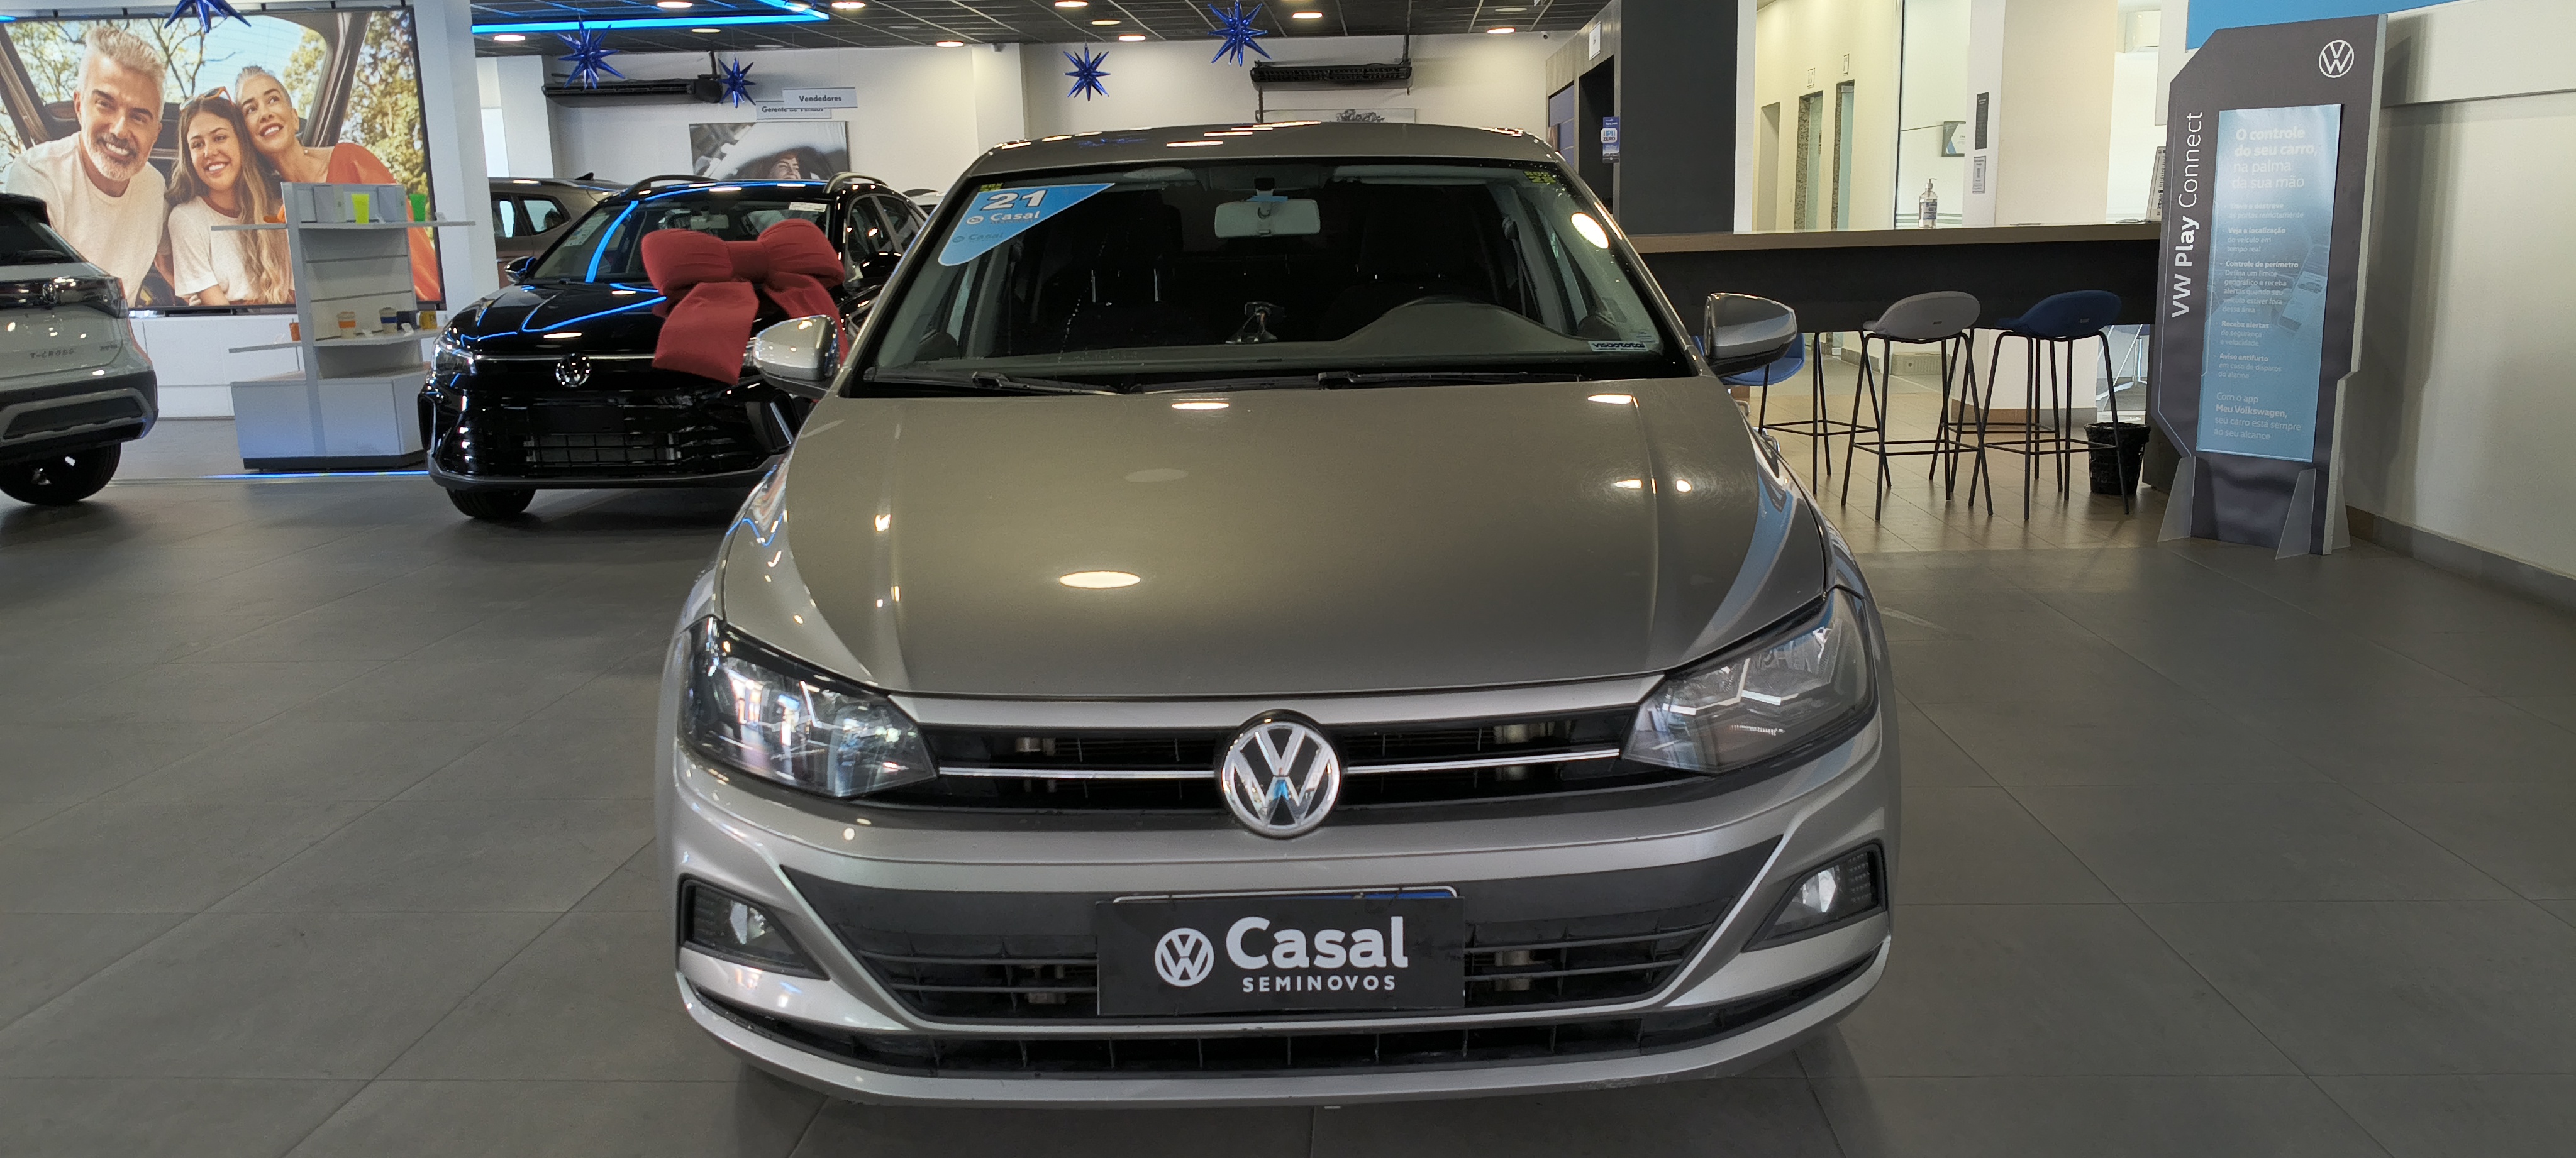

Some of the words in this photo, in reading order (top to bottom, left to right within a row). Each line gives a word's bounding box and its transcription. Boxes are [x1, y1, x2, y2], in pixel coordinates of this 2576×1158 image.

[2235, 128, 2247, 141] O
[2249, 126, 2306, 140] controle
[2235, 145, 2251, 157] do
[2254, 145, 2277, 156] seu
[2280, 145, 2318, 157] carro,
[2179, 112, 2202, 208] Connect
[2233, 163, 2248, 173] na
[2251, 160, 2292, 175] palma
[2232, 177, 2247, 189] da
[2250, 179, 2272, 188] sua
[2275, 175, 2304, 188] mão
[980, 189, 1049, 211] 21
[990, 211, 1040, 221] Casal
[2249, 226, 2286, 234] localização
[2175, 216, 2199, 267] Play
[2172, 274, 2191, 317] VW
[2216, 392, 2235, 400] Com
[2243, 396, 2258, 404] app
[2216, 404, 2233, 412] Meu
[2235, 405, 2287, 419] Volkswagen,
[2270, 422, 2302, 431] sempre
[2225, 429, 2239, 438] seu
[2240, 431, 2271, 440] alcance
[1226, 916, 1409, 970] Casal
[1242, 974, 1396, 993] SEMINOVOS
